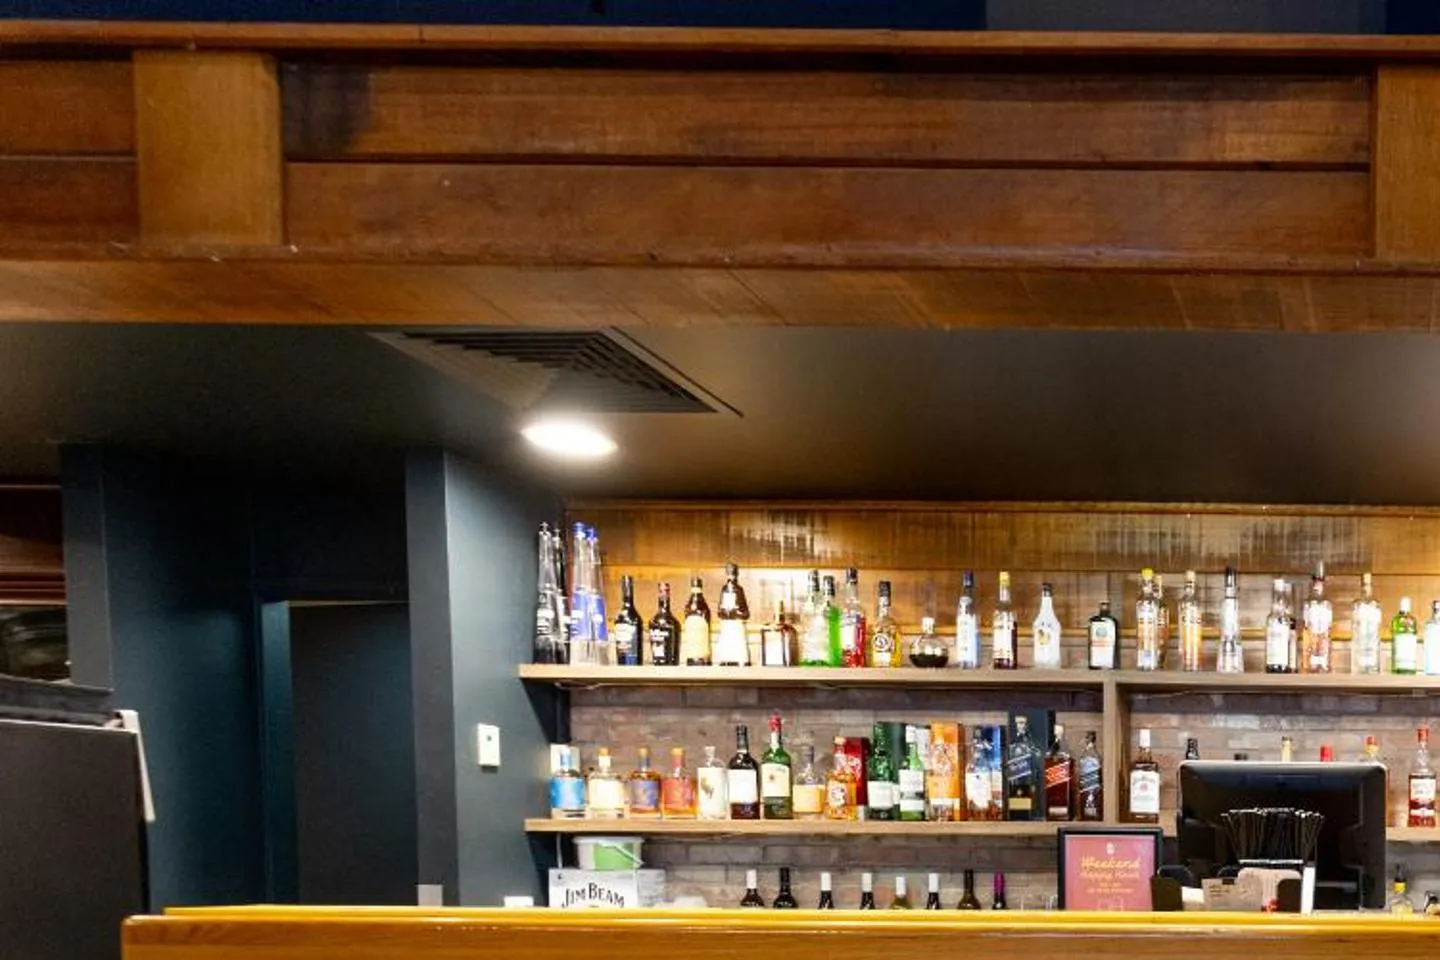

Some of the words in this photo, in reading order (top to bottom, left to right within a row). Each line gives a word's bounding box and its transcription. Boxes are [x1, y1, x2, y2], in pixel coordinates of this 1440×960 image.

[1081, 856, 1141, 869] Weekend
[561, 887, 586, 908] JIM
[588, 882, 625, 908] BEAM
